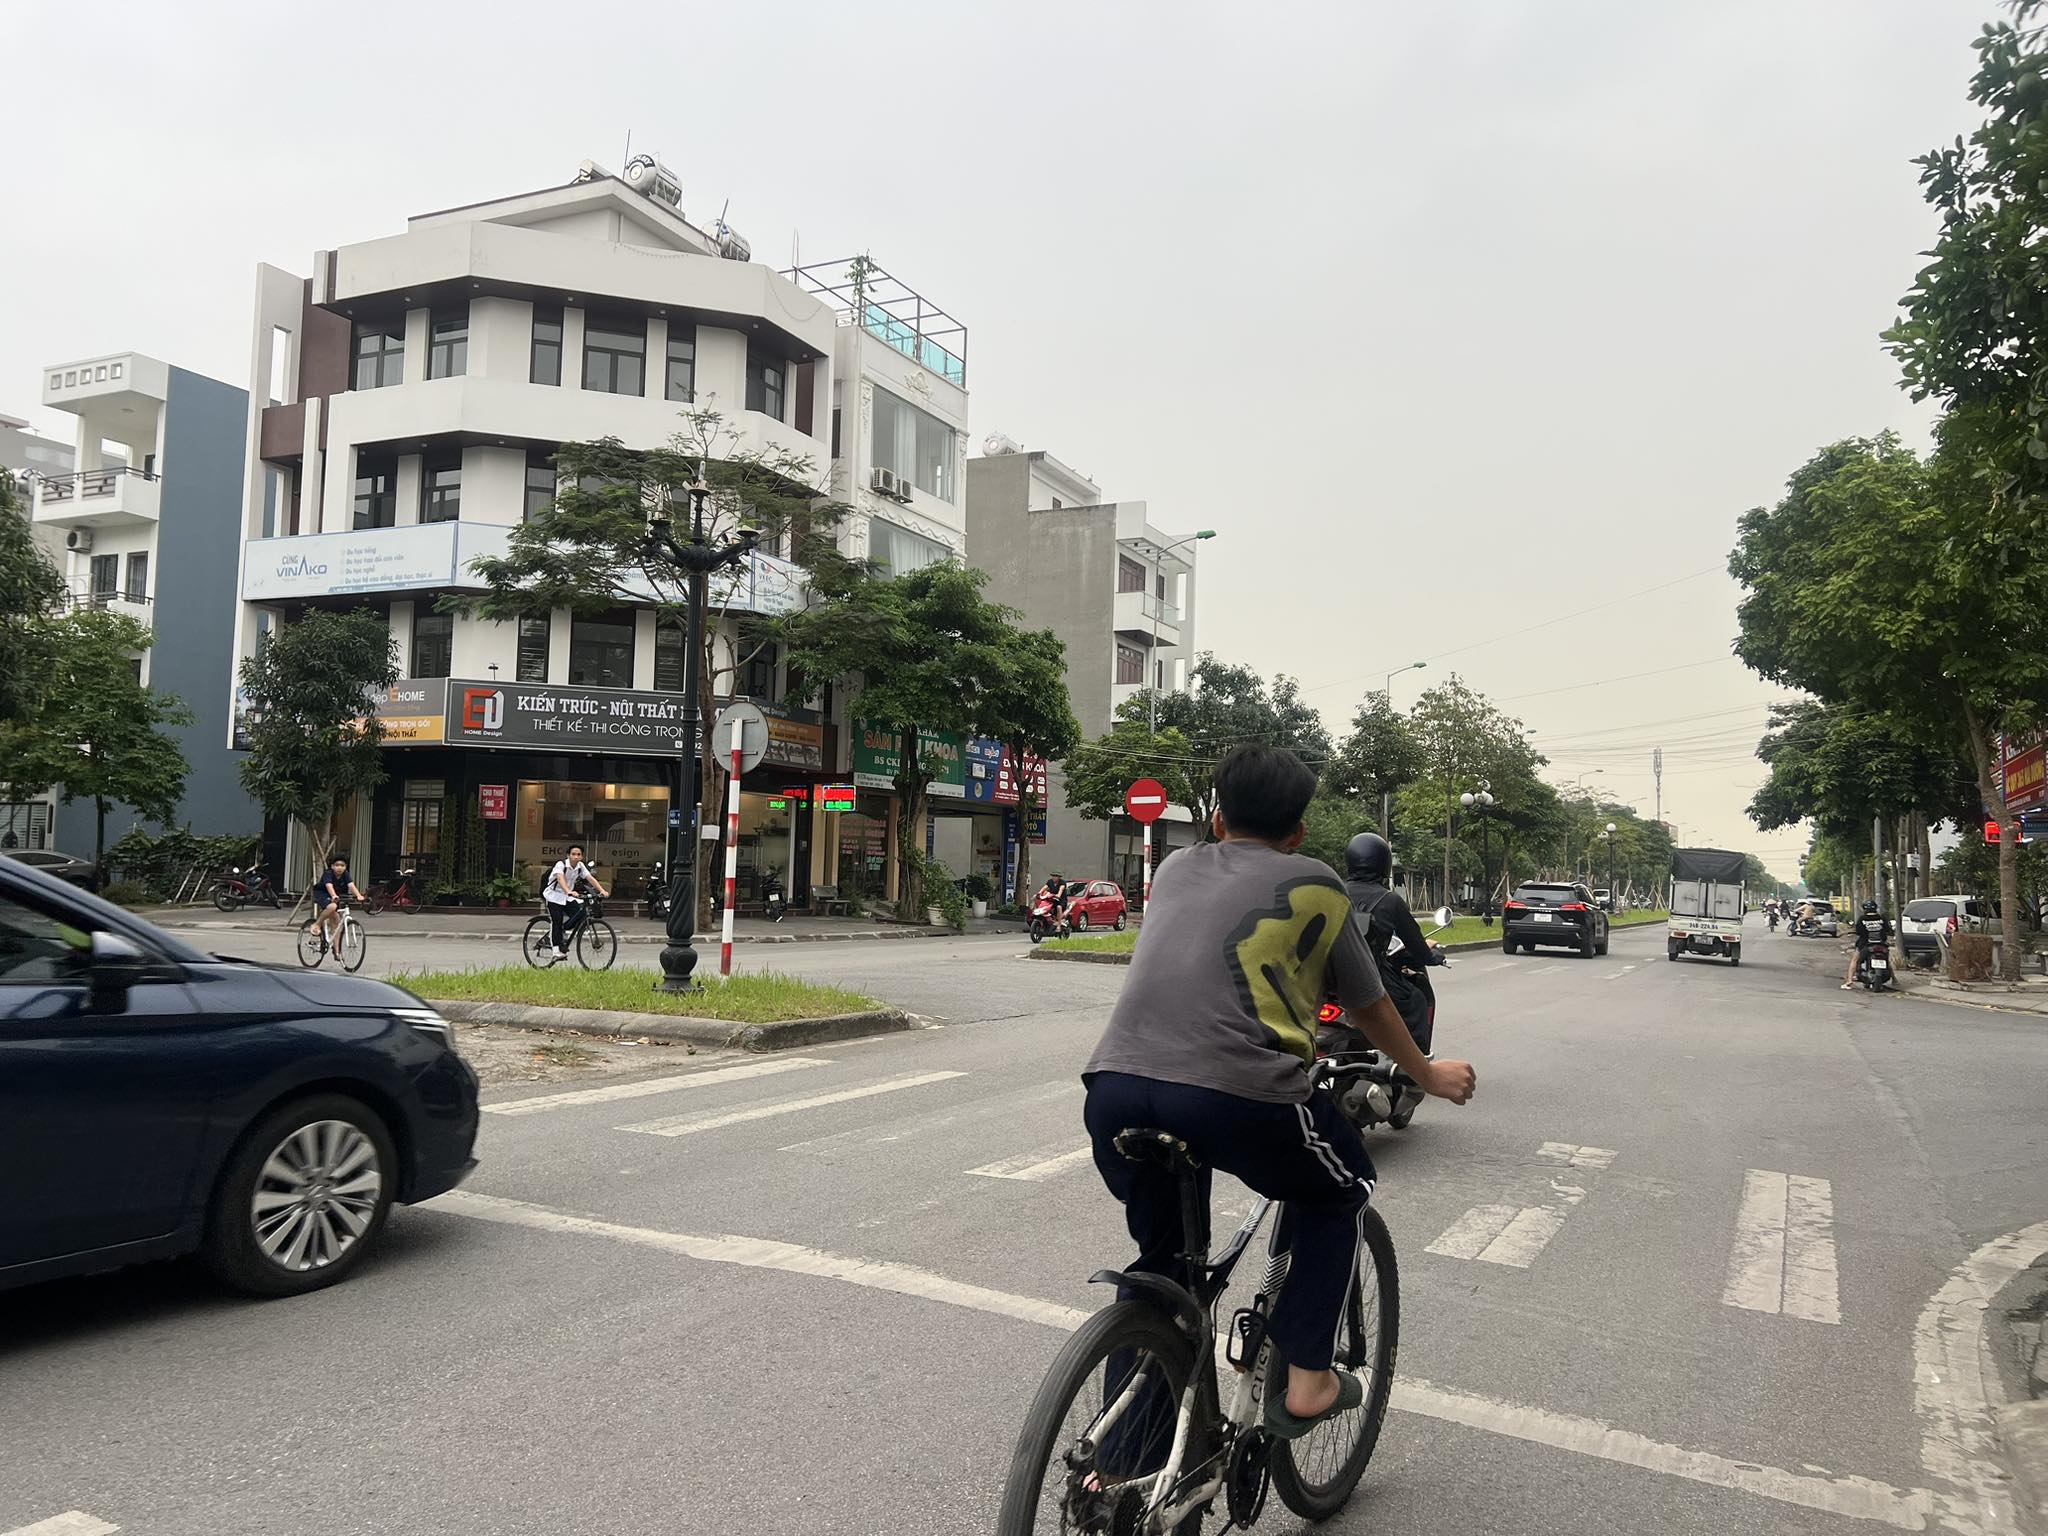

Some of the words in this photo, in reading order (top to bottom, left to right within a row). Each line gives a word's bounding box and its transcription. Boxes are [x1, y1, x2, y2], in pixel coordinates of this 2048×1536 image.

[276, 554, 328, 577] VINAKO
[517, 691, 556, 712] KIẾN
[560, 696, 598, 715] TRÚC
[609, 698, 634, 719] NỘI
[637, 699, 677, 719] THẤT
[533, 716, 563, 731] THIẾT
[609, 721, 651, 736] CÔNG
[864, 725, 892, 751] SẢN
[874, 755, 884, 765] BS
